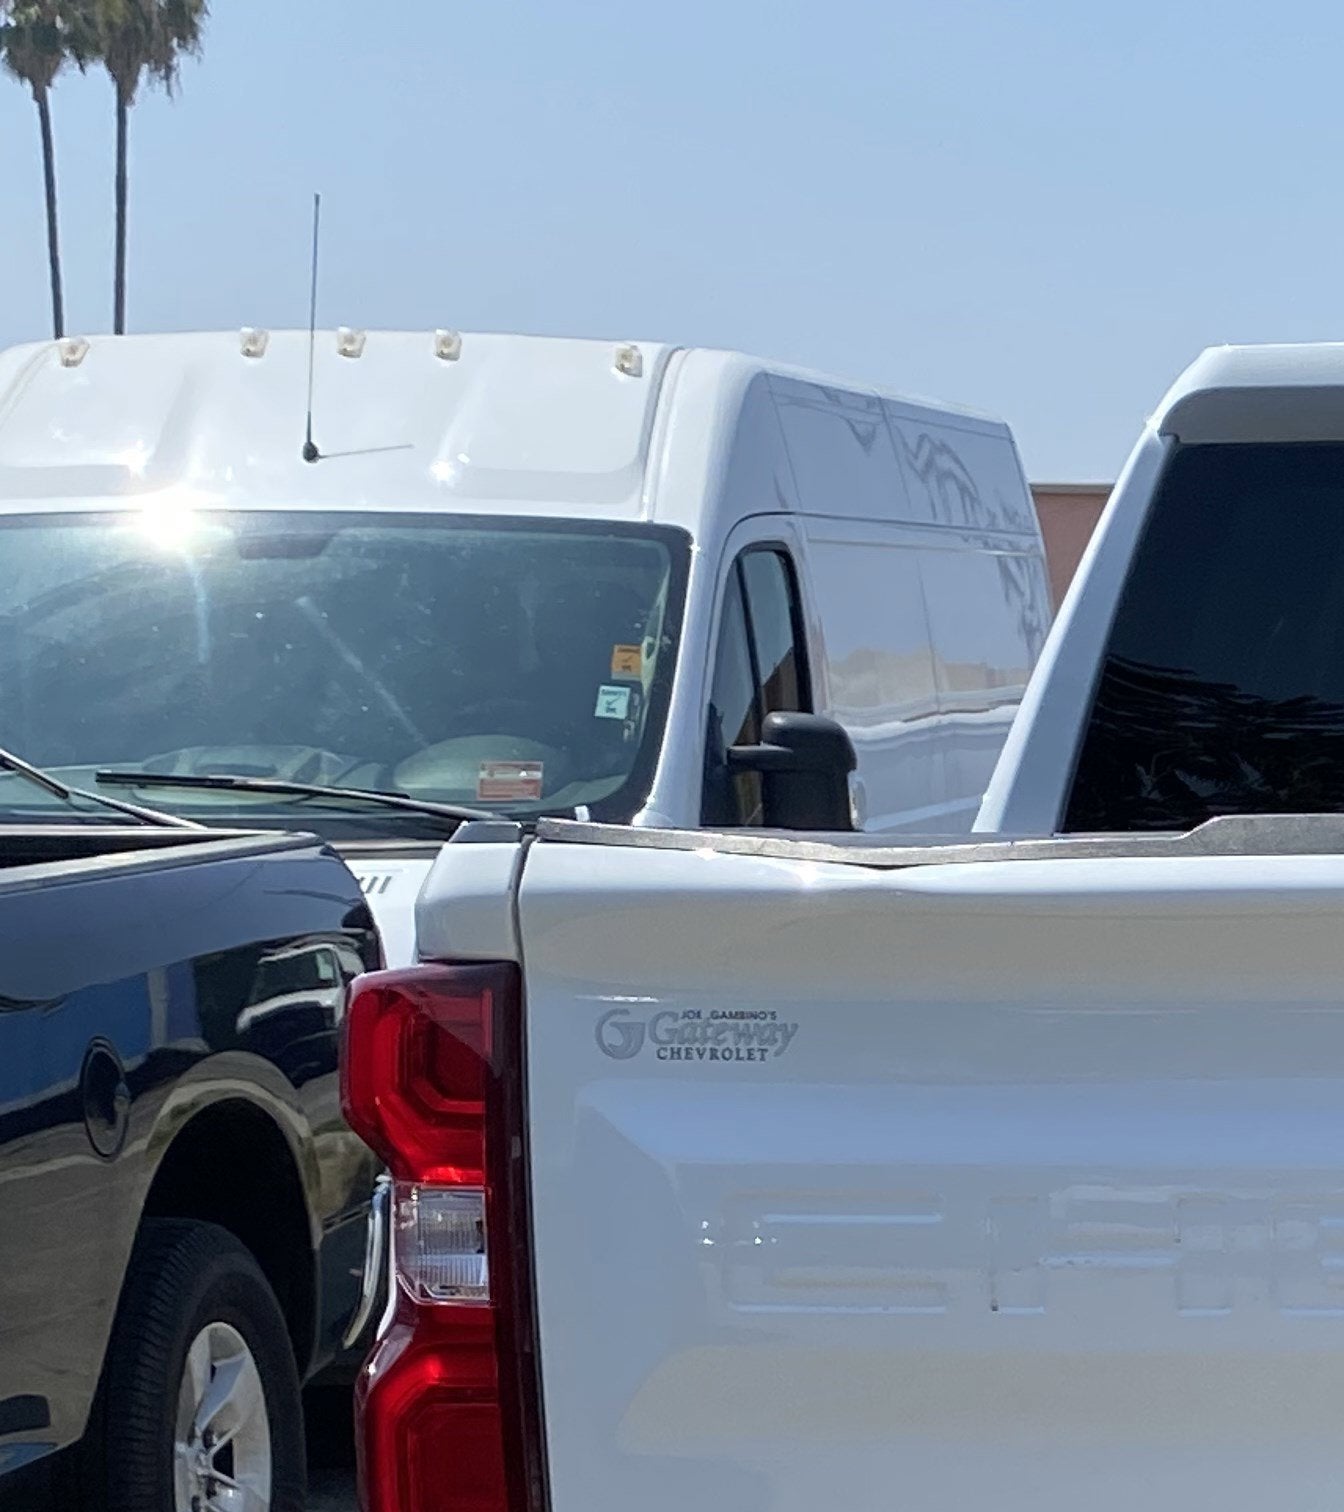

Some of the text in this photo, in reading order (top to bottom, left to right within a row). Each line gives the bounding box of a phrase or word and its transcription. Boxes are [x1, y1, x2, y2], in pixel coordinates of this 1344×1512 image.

[680, 1010, 702, 1020] JOE
[650, 1010, 799, 1058] Gateway
[656, 1046, 769, 1062] CHEVROLET
